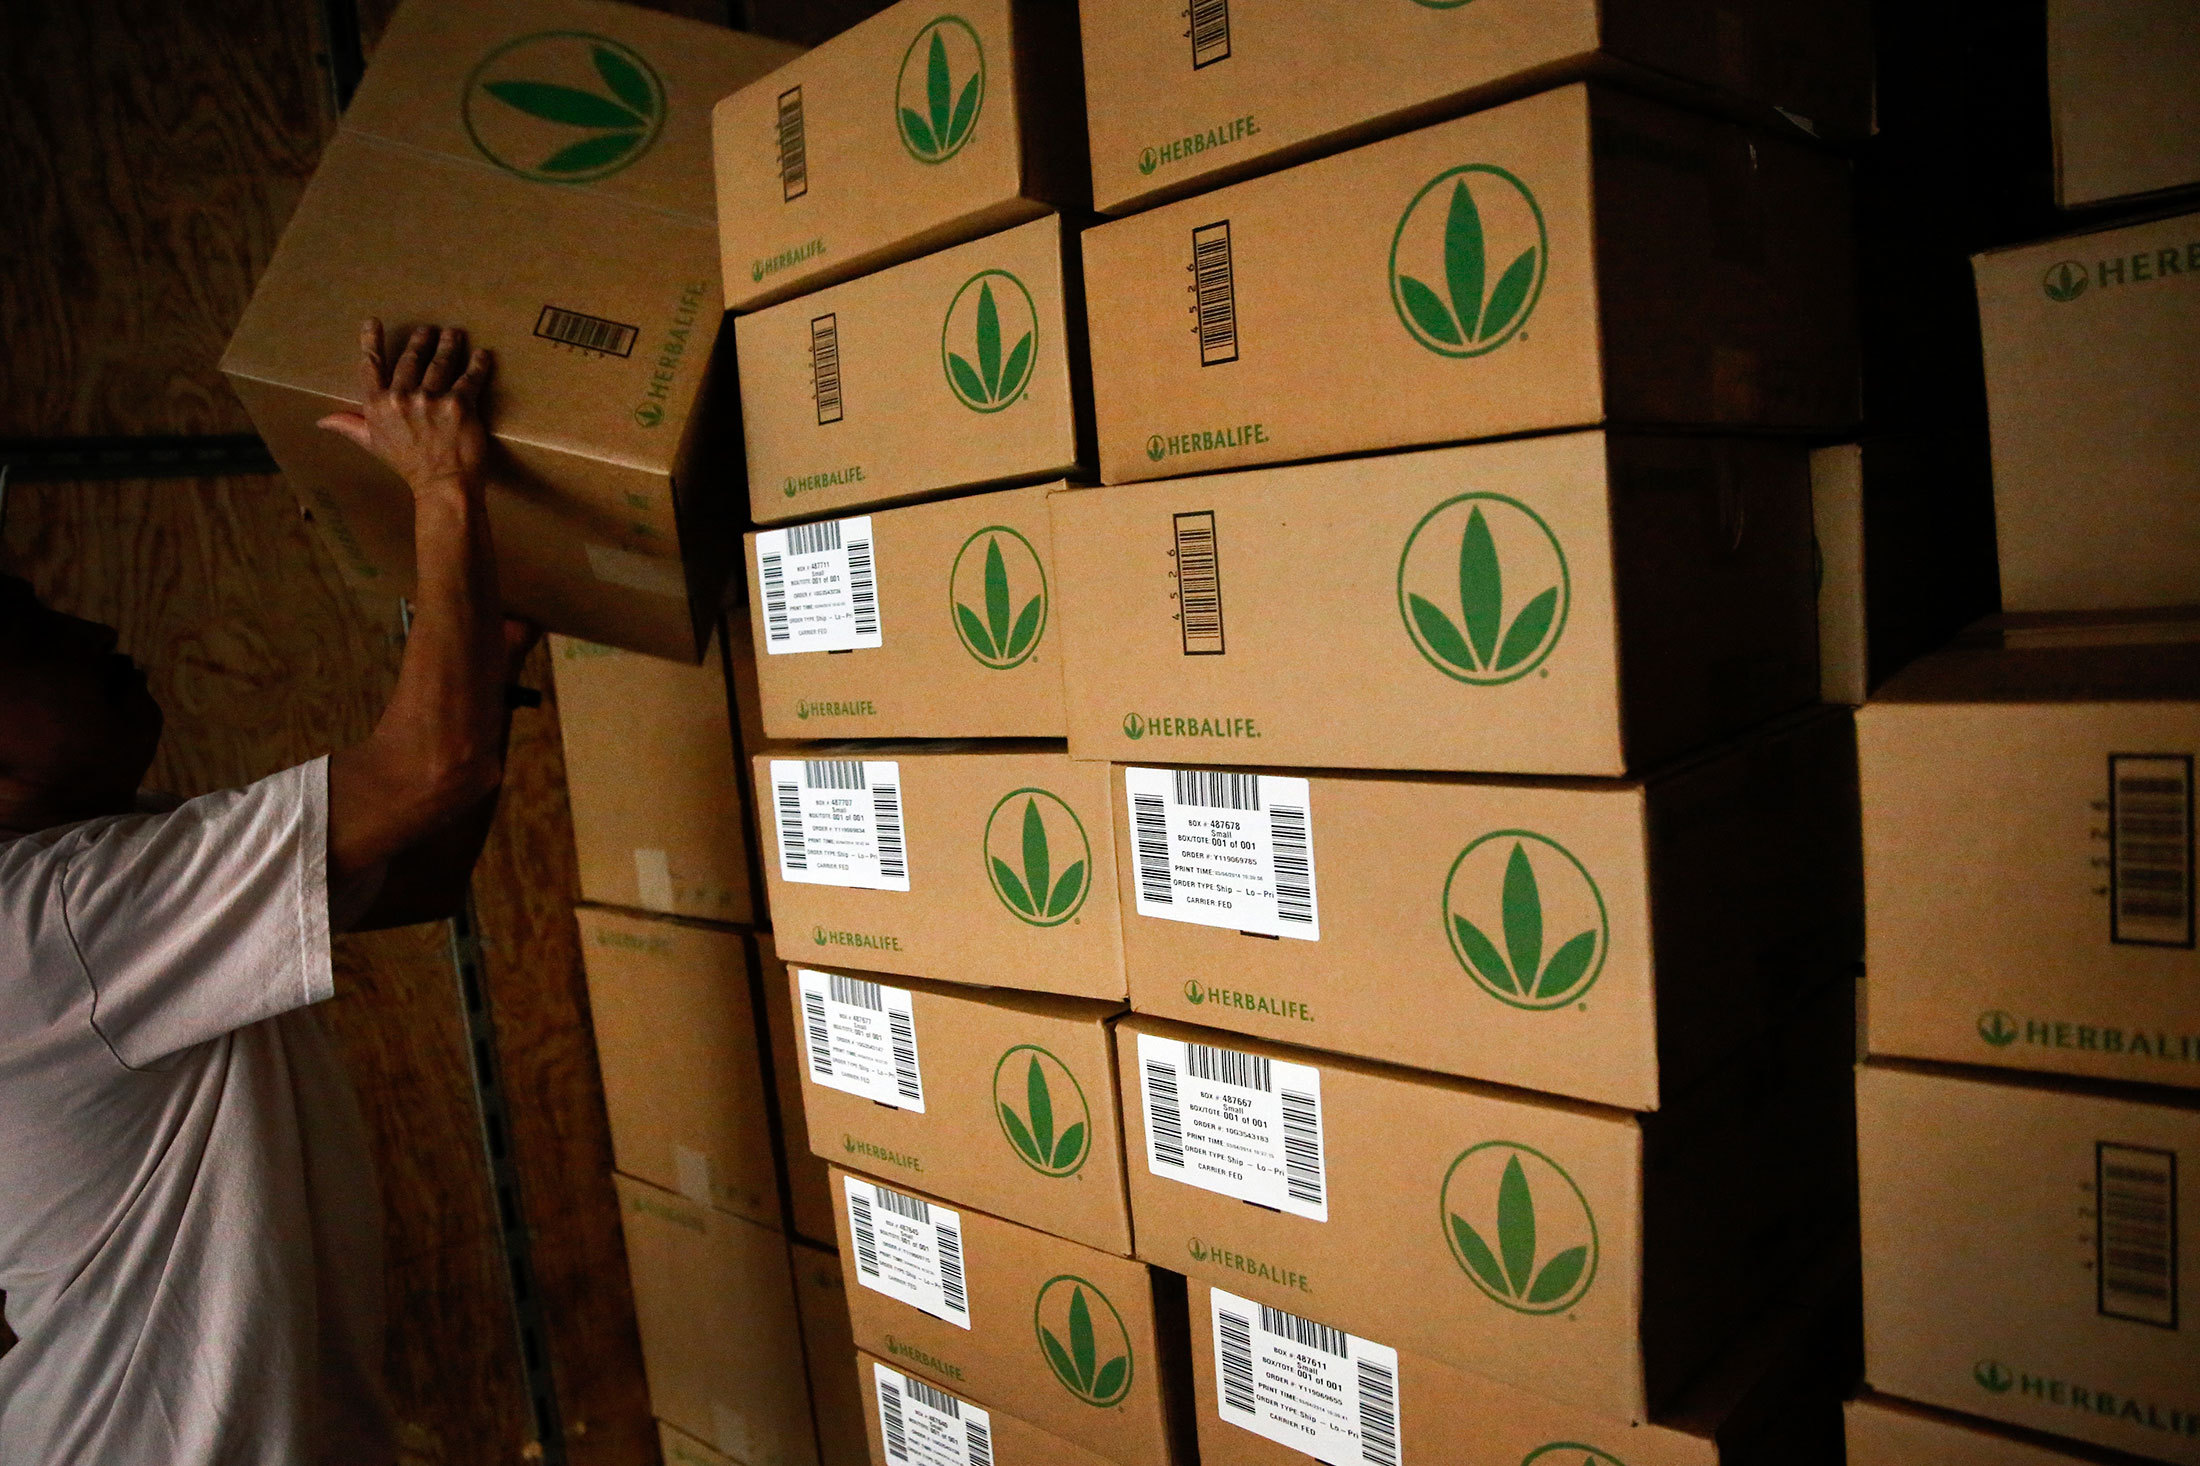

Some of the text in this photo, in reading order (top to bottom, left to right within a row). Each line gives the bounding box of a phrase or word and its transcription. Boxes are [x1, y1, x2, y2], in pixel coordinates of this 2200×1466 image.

[1211, 820, 1241, 831] 487678
[1211, 830, 1232, 838] Small
[1212, 838, 1226, 847] 001
[1230, 841, 1238, 849] of
[1241, 841, 1256, 850] 001
[1182, 851, 1205, 859] ORDER
[1175, 865, 1194, 873] PRINT
[1173, 879, 1196, 888] ORDER
[1216, 884, 1233, 894] Ship
[1218, 900, 1232, 909] FED
[2027, 1020, 2200, 1062] HERBALI
[1223, 1095, 1252, 1108] 487667
[1223, 1104, 1244, 1114] Small
[1194, 1120, 1216, 1130] ORDER
[1224, 1112, 1238, 1122] 001
[1242, 1117, 1250, 1125] of
[1252, 1119, 1267, 1128] 001
[1187, 1132, 1205, 1142] PRINT
[1185, 1145, 1207, 1156] ORDER
[1228, 1156, 1244, 1167] Ship
[1229, 1171, 1243, 1181] FED
[1297, 1354, 1326, 1370] 487611
[1297, 1362, 1318, 1375] Small
[1266, 1372, 1289, 1385] ORDER
[1297, 1370, 1312, 1381] 001
[1327, 1381, 1342, 1392] 001
[1258, 1382, 1278, 1394] PRINT
[1257, 1394, 1279, 1407] ORDER
[1300, 1411, 1317, 1423] Ship
[1301, 1425, 1316, 1436] FED
